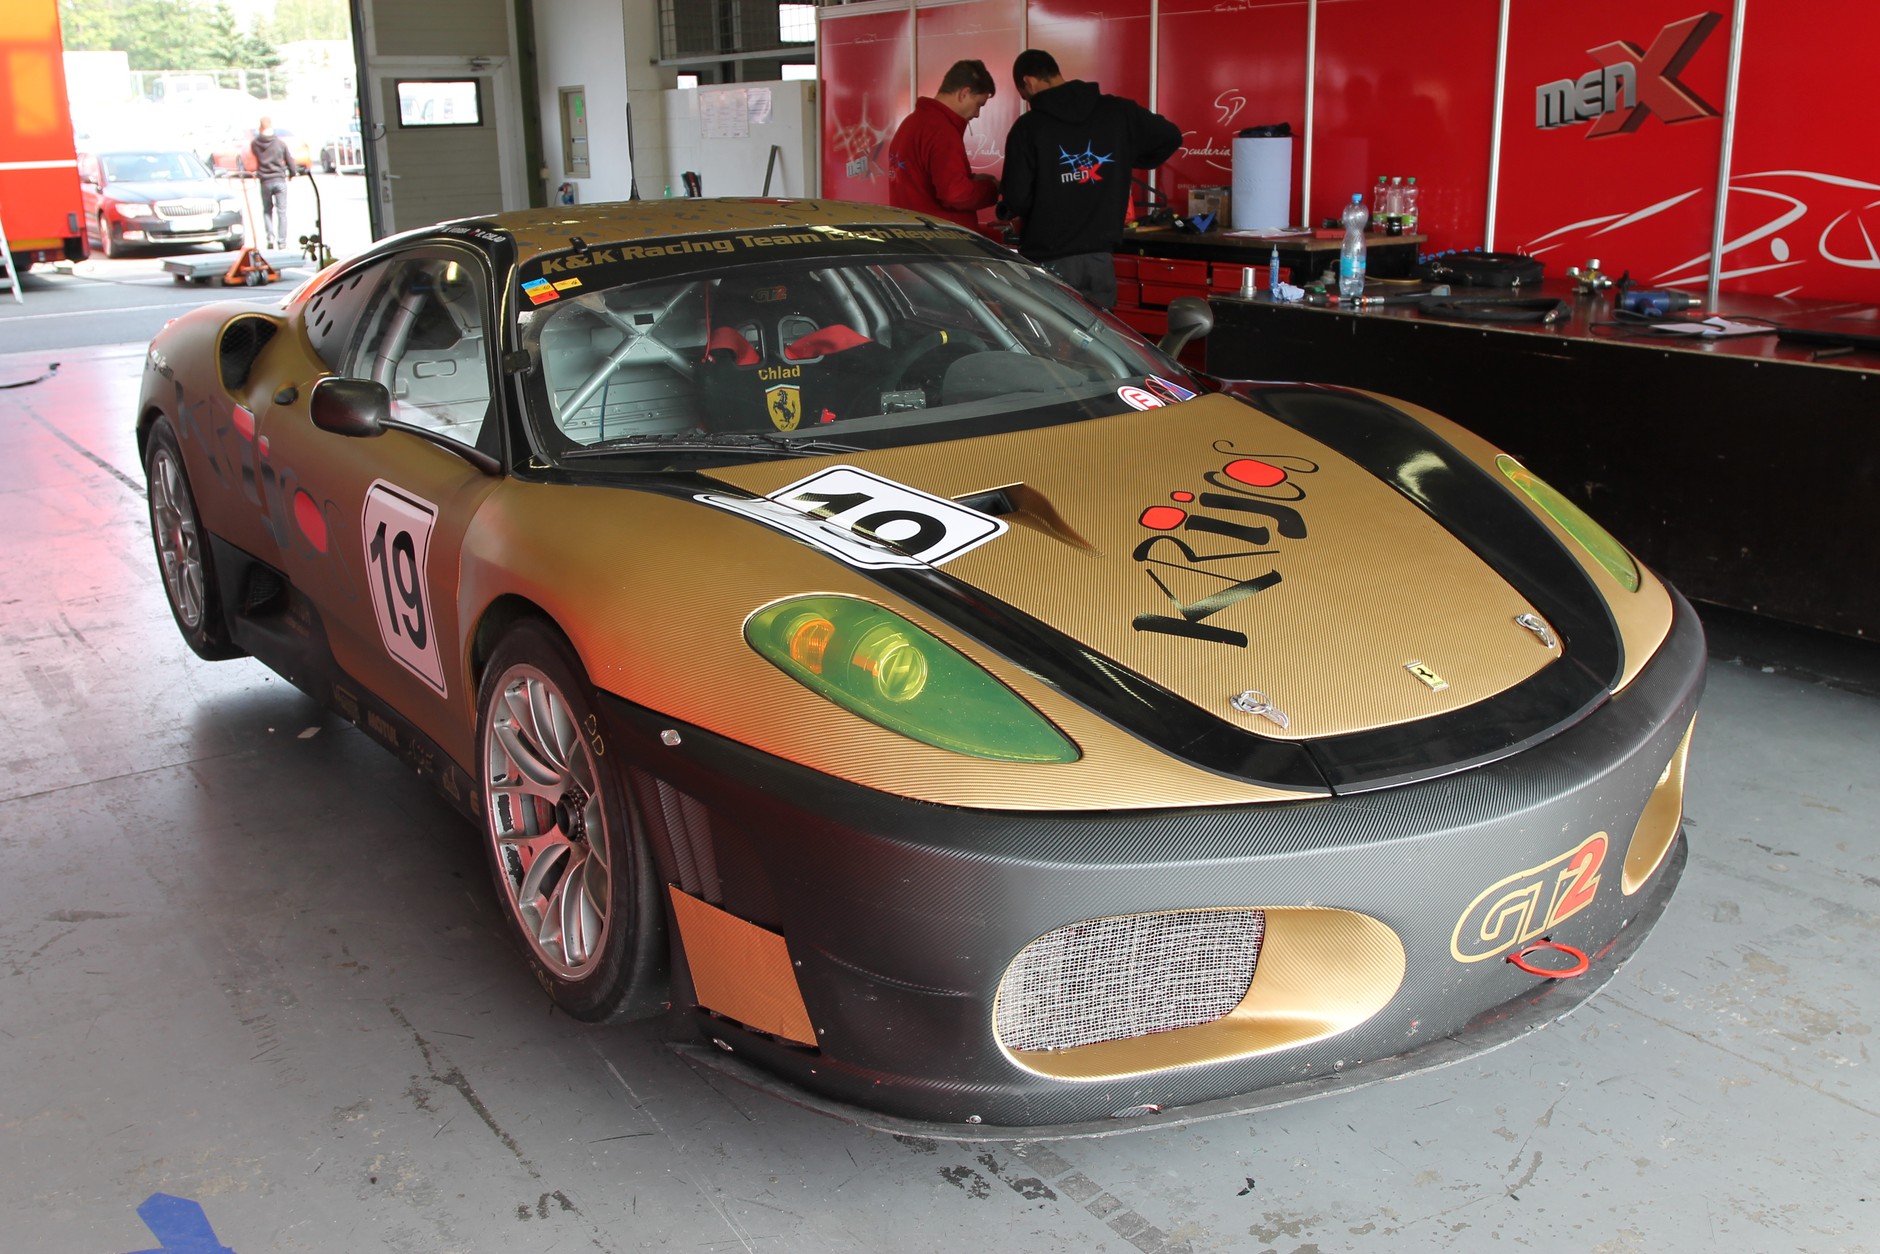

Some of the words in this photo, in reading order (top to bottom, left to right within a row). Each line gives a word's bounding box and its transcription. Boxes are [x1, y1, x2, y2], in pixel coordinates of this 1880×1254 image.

[541, 248, 620, 275] K&K
[622, 238, 734, 261] Racing
[736, 231, 821, 248] Team
[891, 229, 977, 243] Republic
[758, 364, 801, 381] Chlad
[369, 520, 428, 651] 19
[1450, 830, 1609, 964] GT2
